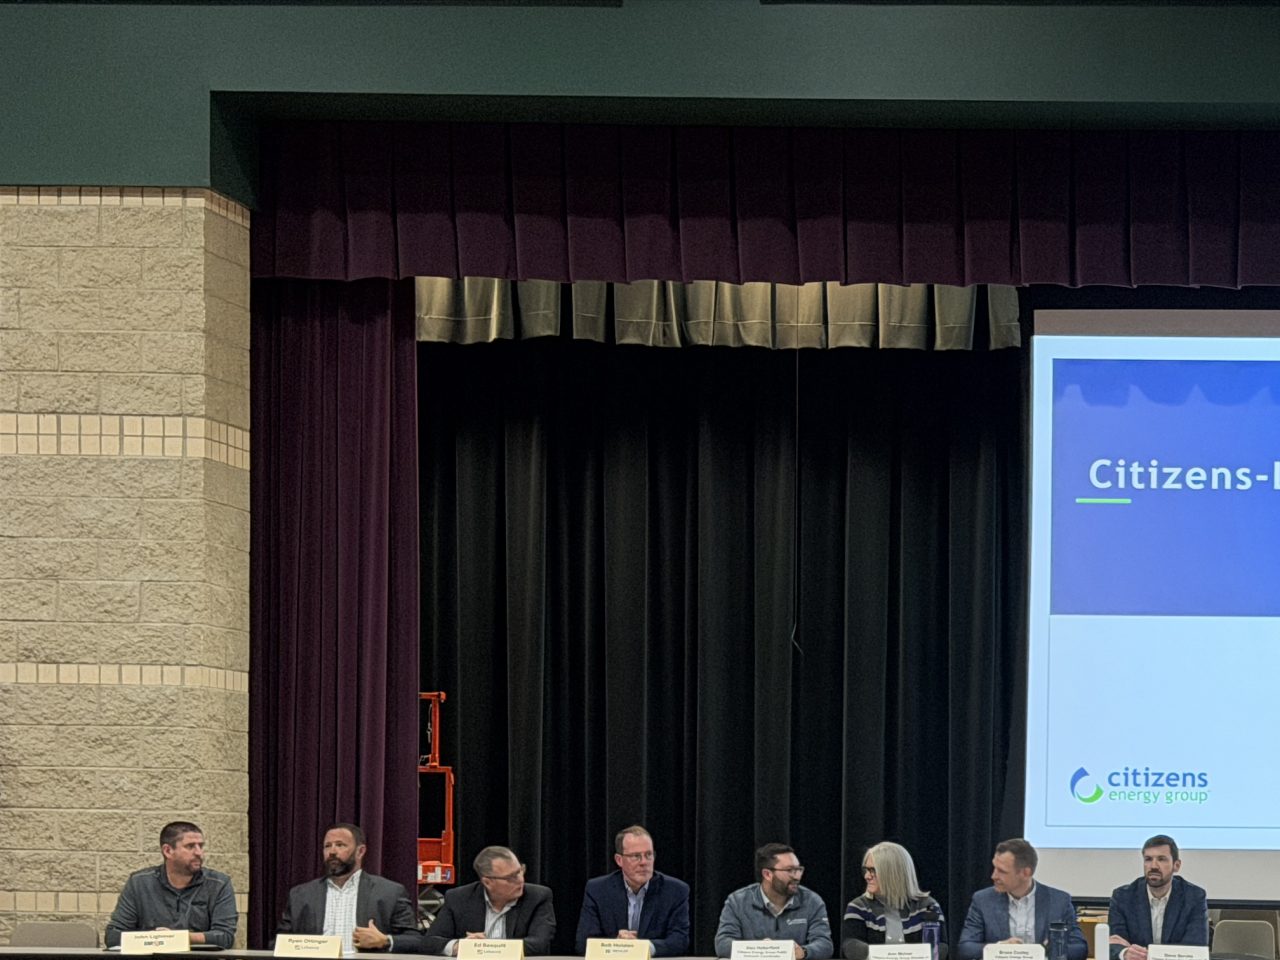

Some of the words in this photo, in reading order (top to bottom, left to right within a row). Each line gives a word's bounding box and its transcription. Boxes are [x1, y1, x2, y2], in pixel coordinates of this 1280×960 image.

[1107, 766, 1209, 787] citizens
[1108, 789, 1160, 804] energy
[1165, 789, 1208, 804] group
